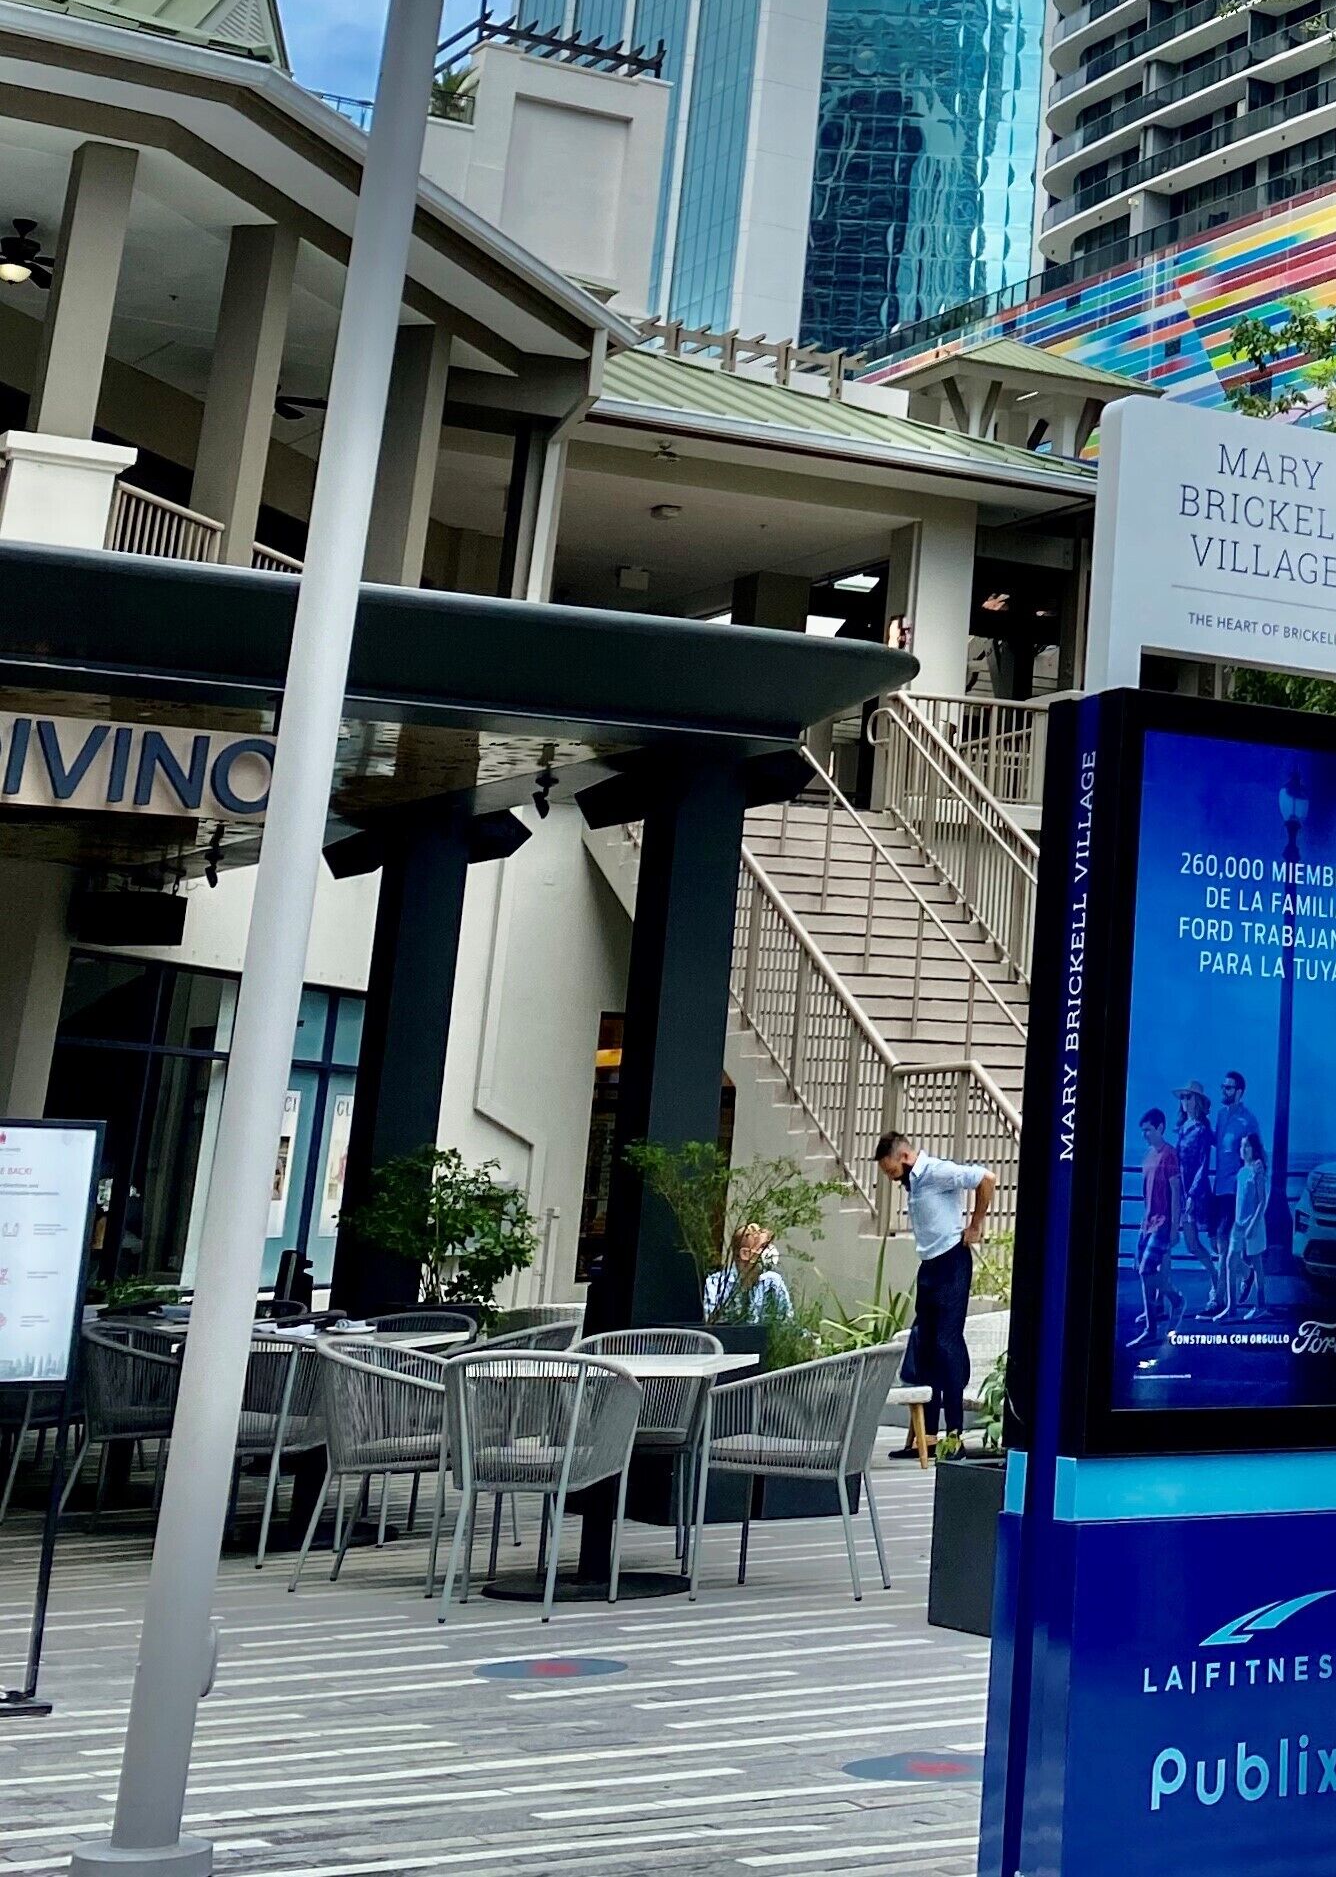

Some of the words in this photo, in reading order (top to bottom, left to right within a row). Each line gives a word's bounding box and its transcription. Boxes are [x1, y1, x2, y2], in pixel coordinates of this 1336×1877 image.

[1217, 443, 1324, 491] MARY
[1188, 612, 1213, 627] THE
[1216, 616, 1258, 633] HEART
[1262, 623, 1279, 636] OF
[0, 717, 277, 814] IVINO
[1075, 750, 1096, 883] VILLAGE
[1180, 852, 1264, 881] 260,000
[1206, 886, 1231, 909] DE
[1238, 889, 1263, 912] LA
[1179, 916, 1233, 942] FORD
[1065, 893, 1087, 1052] BRICKELL
[1199, 950, 1253, 976] PARA
[1260, 955, 1286, 979] LA
[1059, 1063, 1078, 1161] MARY
[1170, 1333, 1228, 1345] CONSTRUIDA
[1230, 1334, 1249, 1345] CON
[1250, 1333, 1290, 1345] ORGULLO
